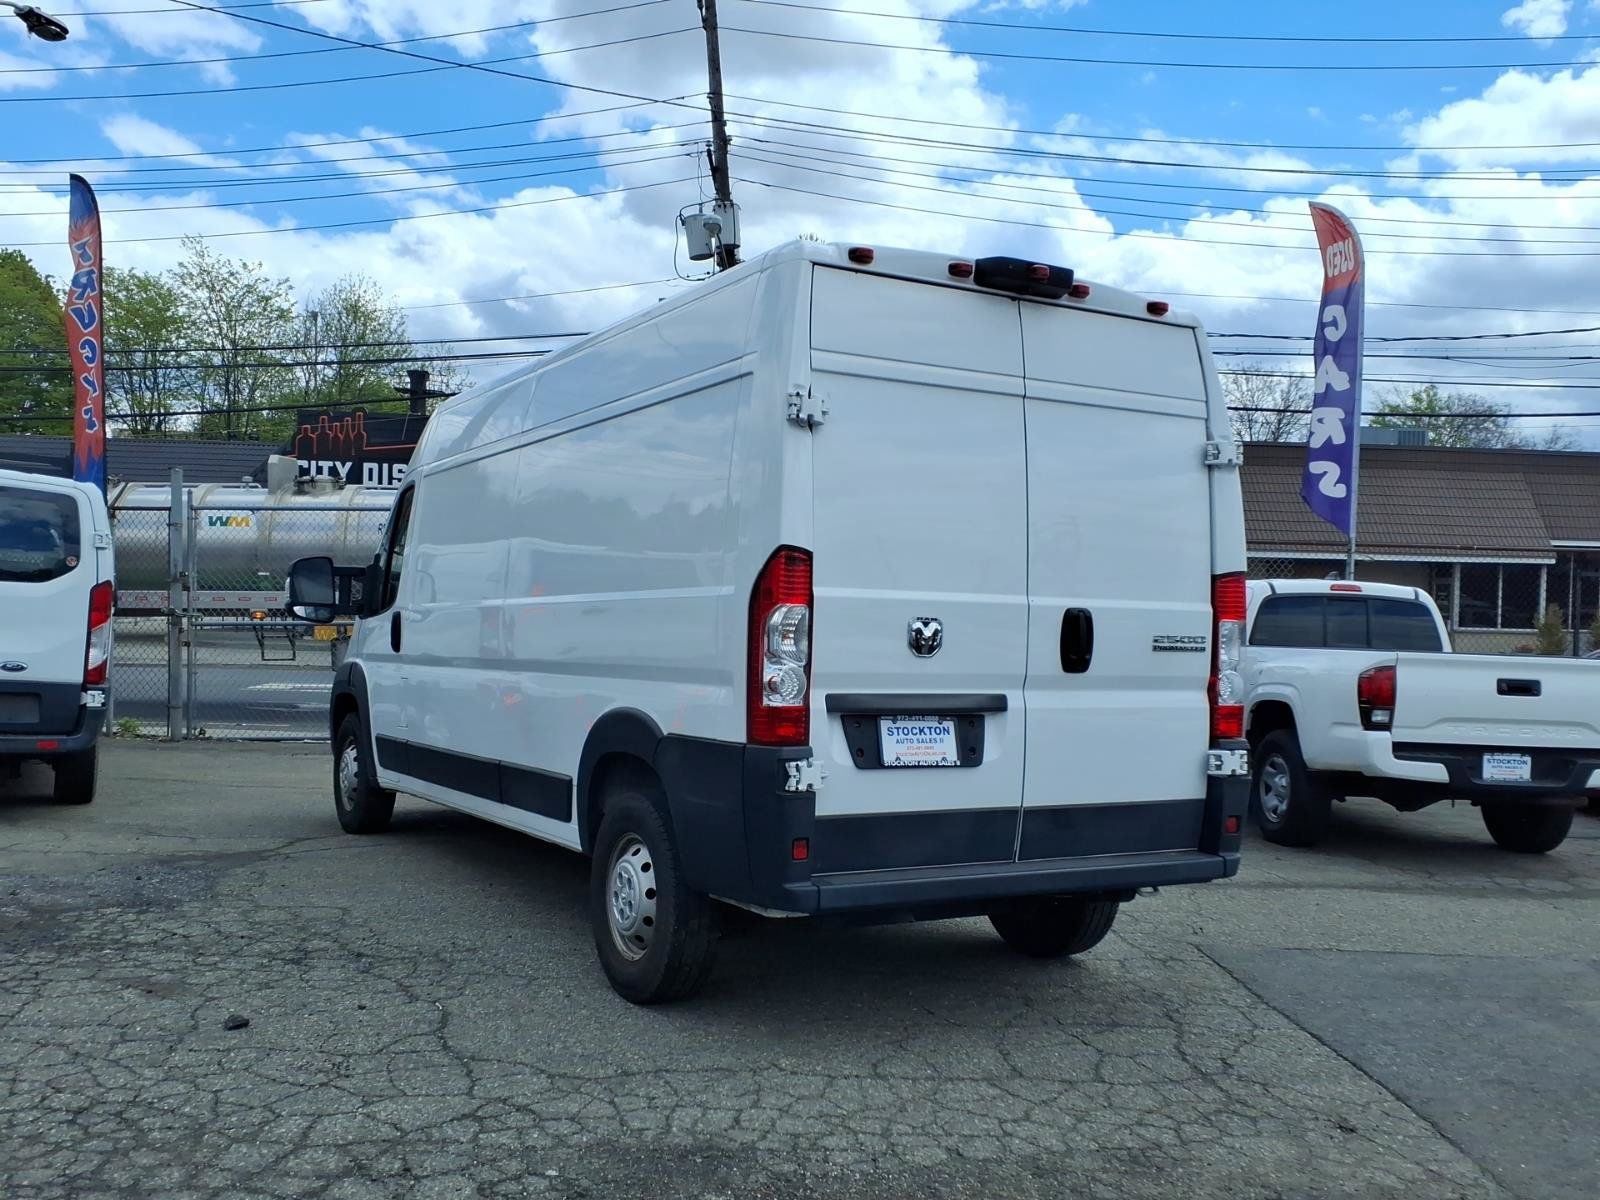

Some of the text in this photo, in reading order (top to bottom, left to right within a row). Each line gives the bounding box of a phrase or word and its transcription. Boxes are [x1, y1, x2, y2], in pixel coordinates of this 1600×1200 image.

[296, 460, 353, 482] CITY
[207, 515, 252, 528] WM
[887, 726, 951, 737] STOCKTON
[1487, 758, 1528, 766] STOCKTON
